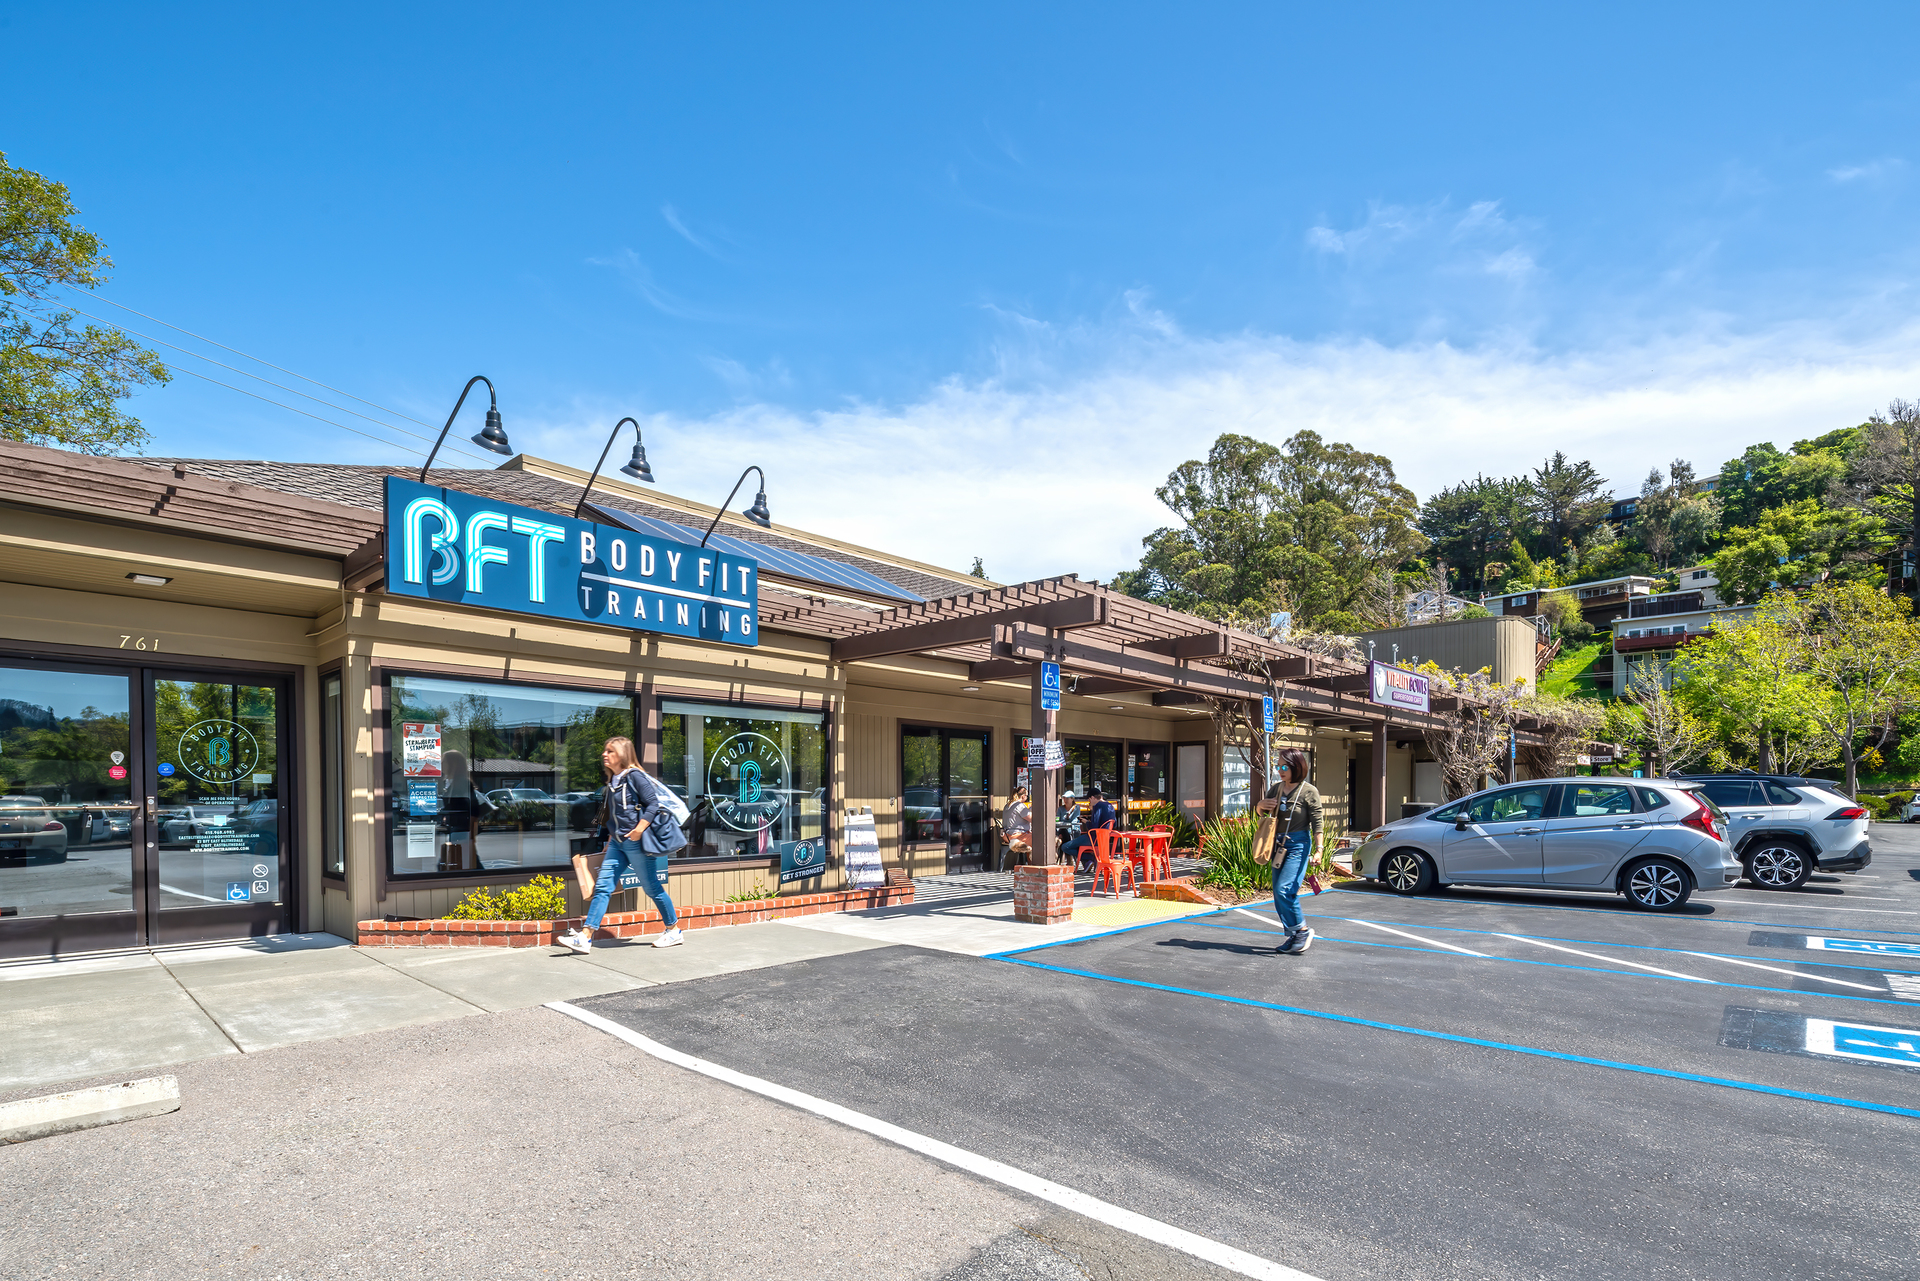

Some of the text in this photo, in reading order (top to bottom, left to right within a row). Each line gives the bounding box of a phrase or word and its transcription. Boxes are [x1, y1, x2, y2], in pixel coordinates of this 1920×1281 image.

[403, 497, 565, 603] BFT
[581, 531, 751, 596] BODY FIT
[581, 585, 751, 636] TRAINING
[120, 635, 159, 651] 761
[190, 724, 248, 742] BODY FIT
[720, 741, 780, 767] BODY FIT
[190, 760, 249, 779] TRAINING
[720, 797, 780, 824] TRAINING
[782, 866, 824, 881] GET STRONGER
